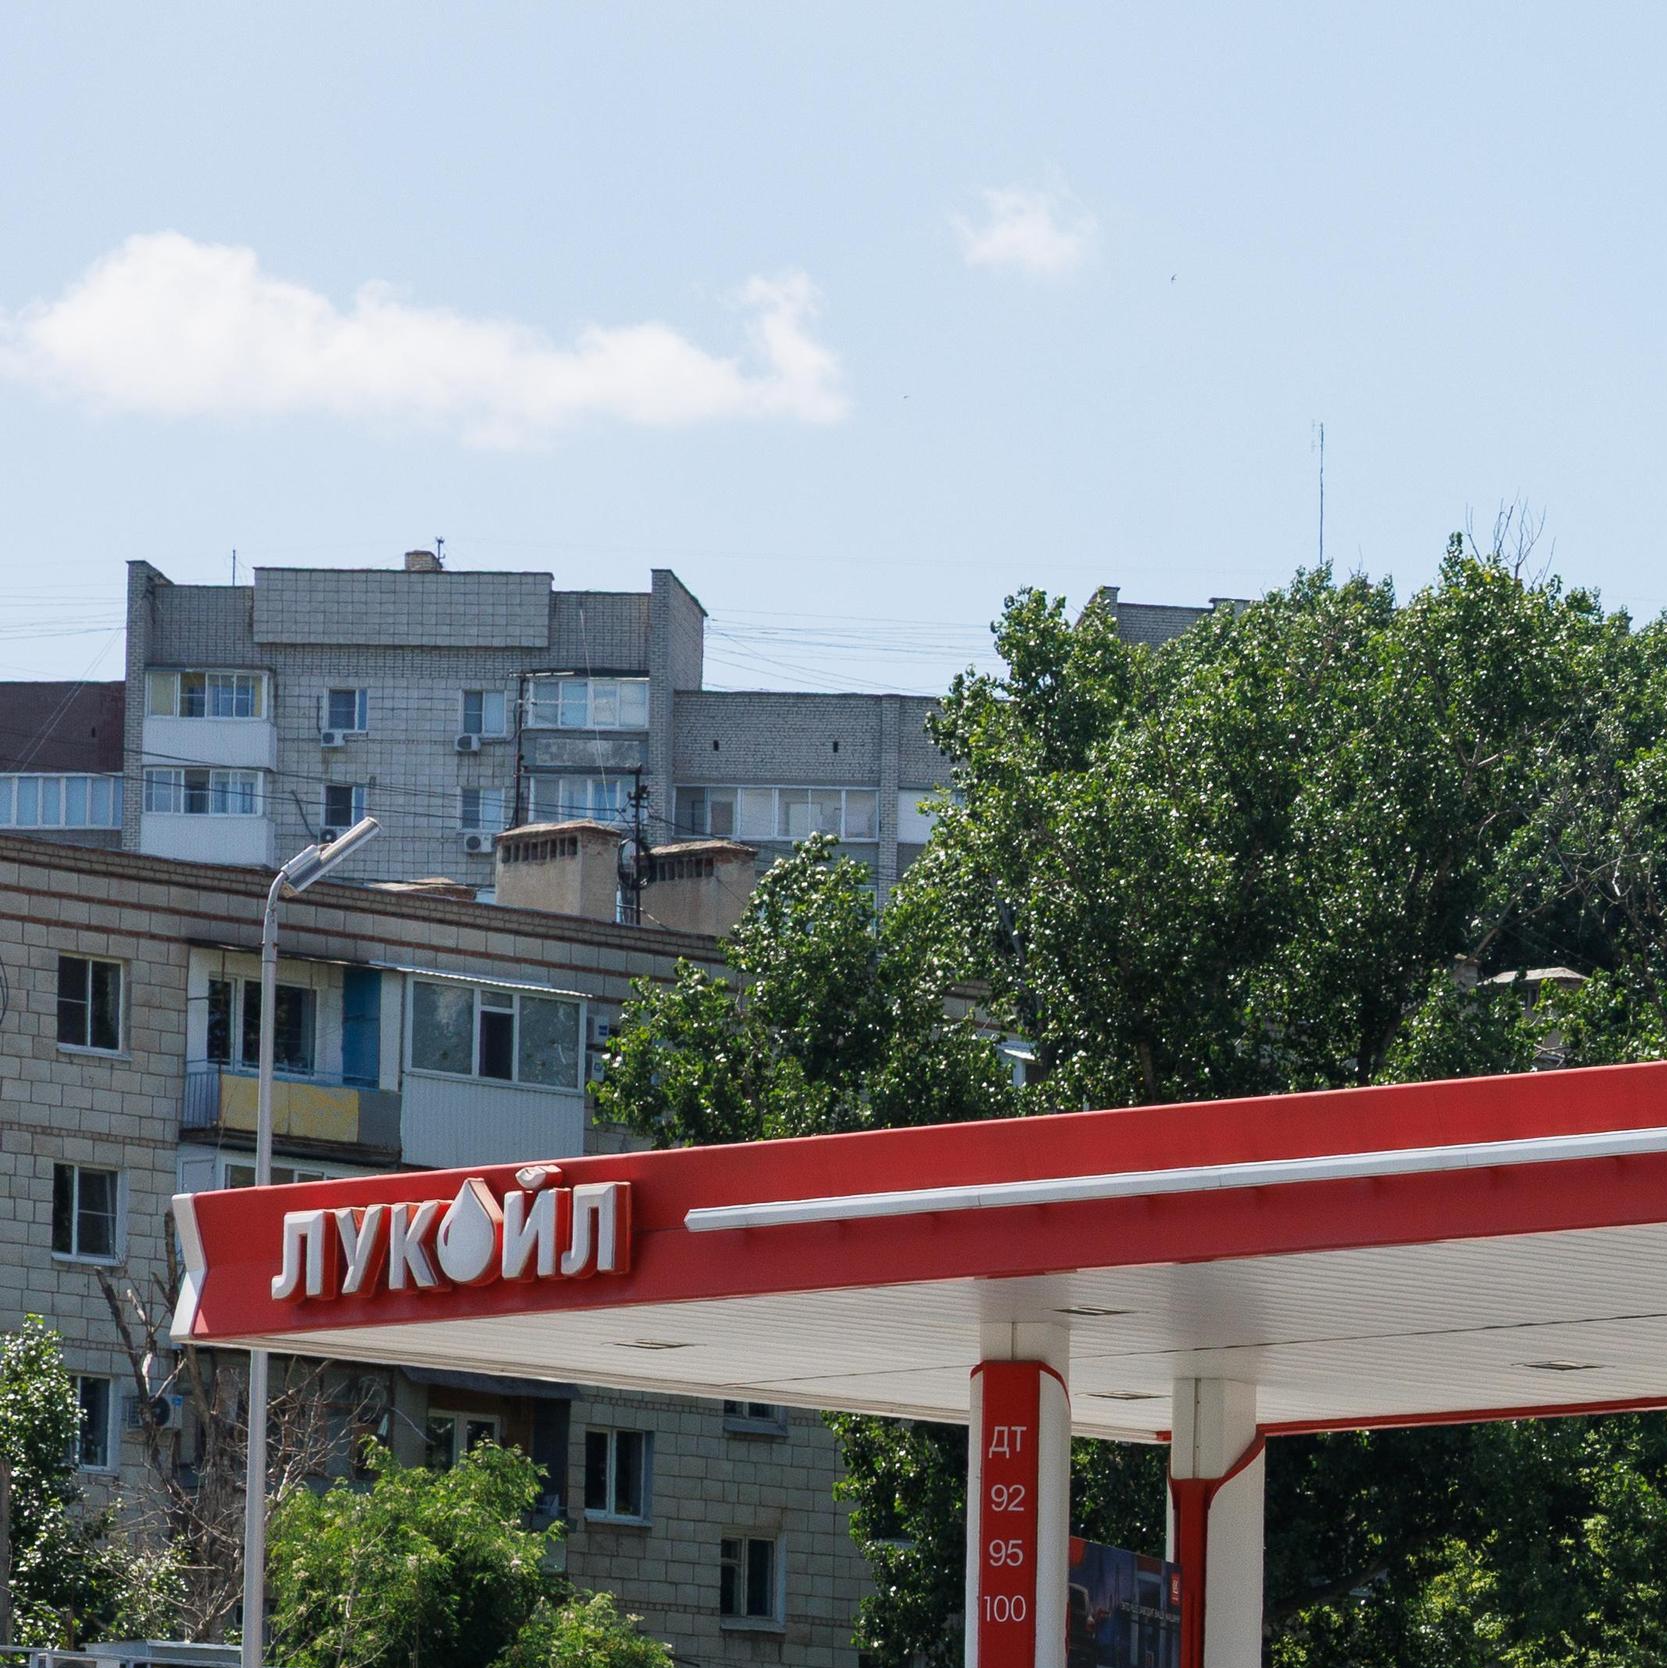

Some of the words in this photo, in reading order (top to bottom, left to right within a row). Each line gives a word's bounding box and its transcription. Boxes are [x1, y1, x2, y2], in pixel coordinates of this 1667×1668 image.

[272, 1165, 630, 1300] ЛУКОЙЛ
[988, 1426, 1027, 1458] ДТ
[991, 1484, 1025, 1511] 92
[989, 1539, 1023, 1567] 95
[984, 1595, 1026, 1622] 100
